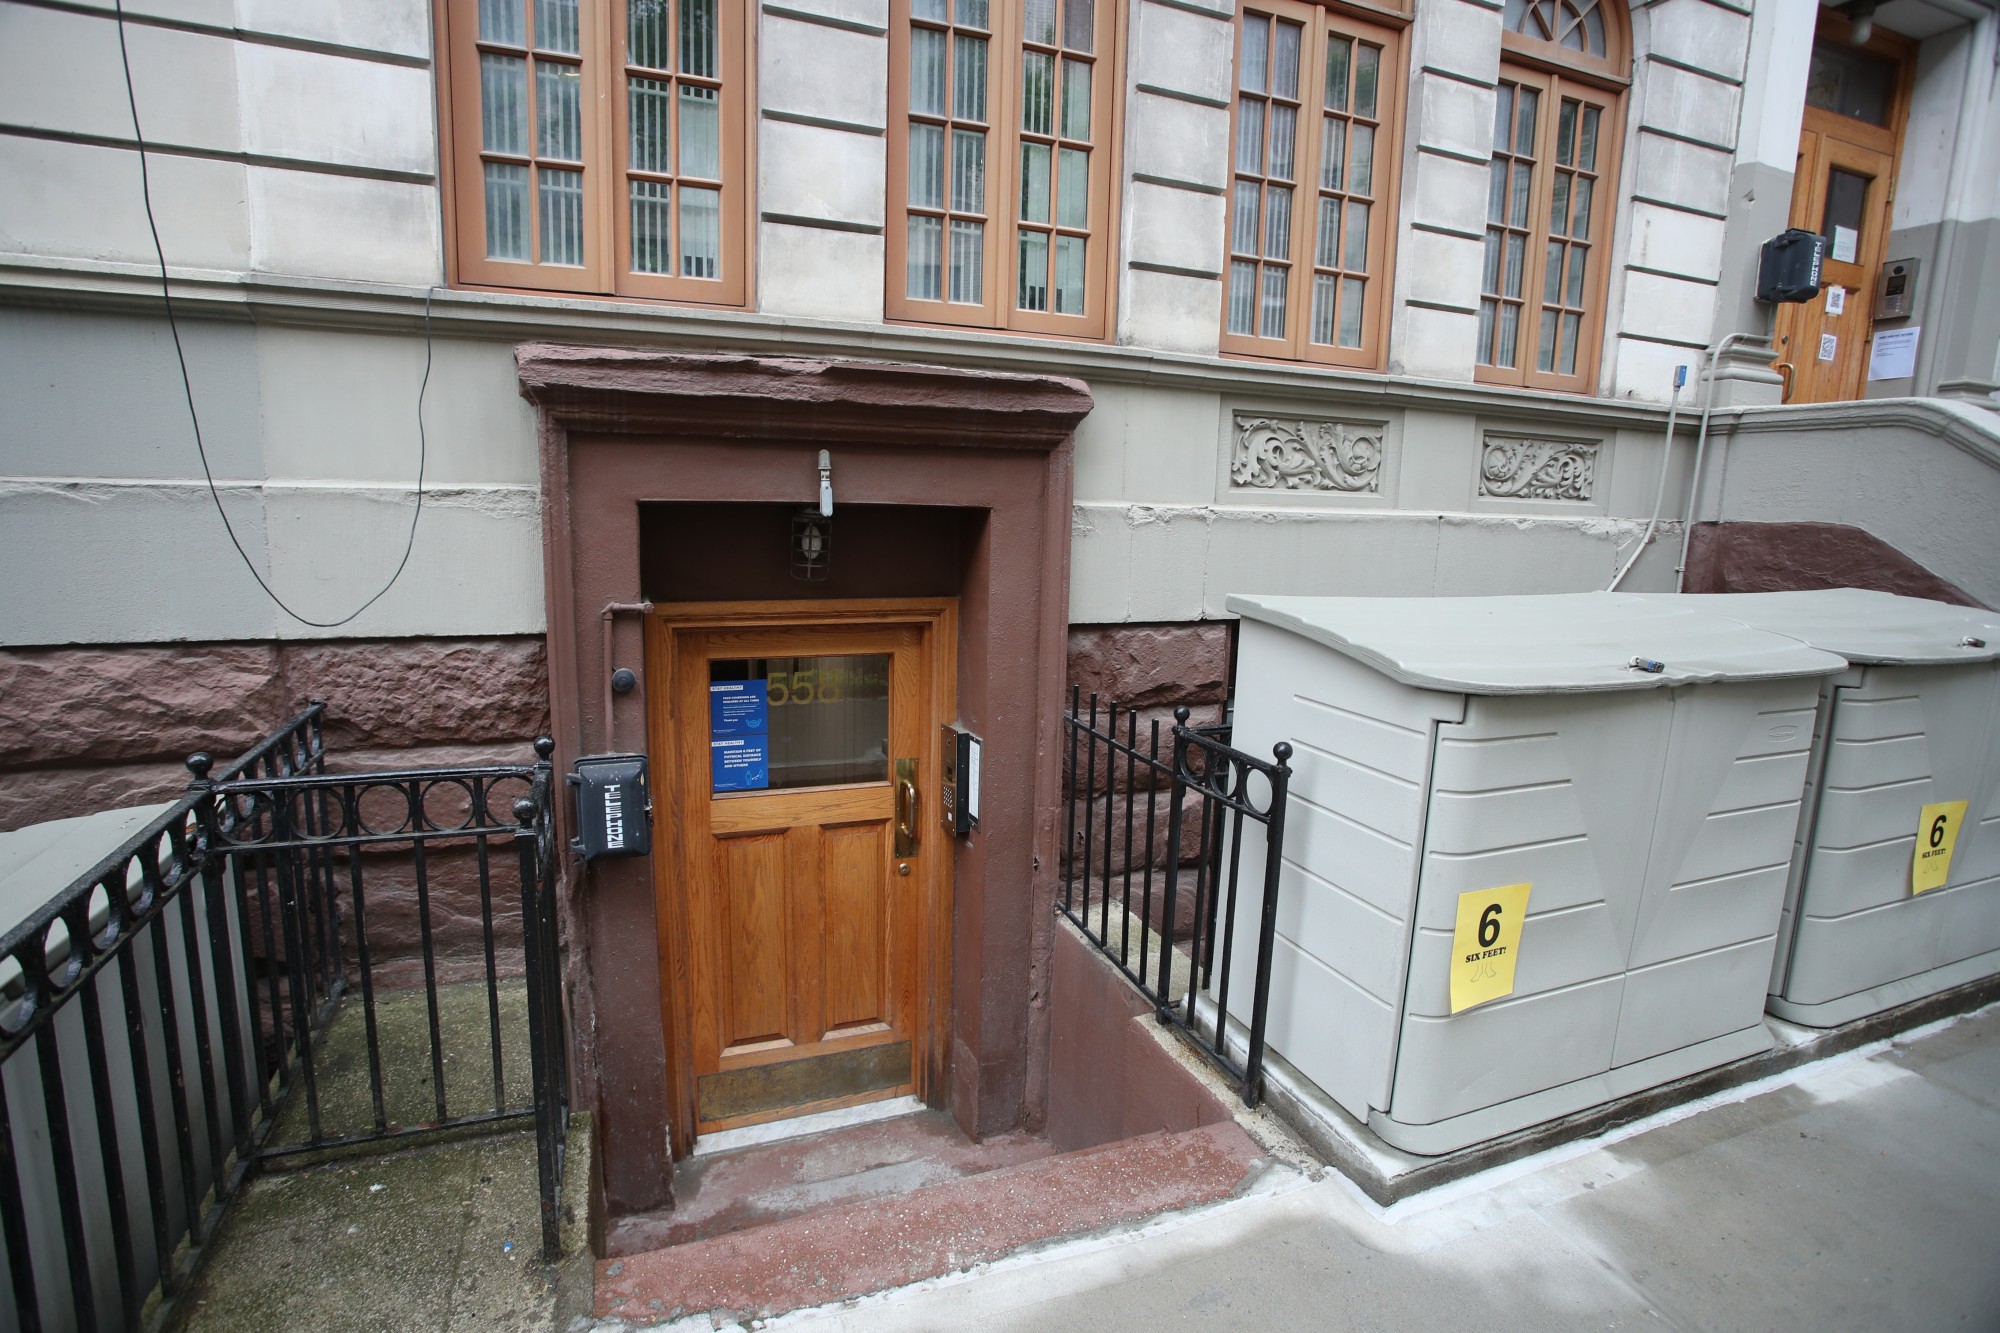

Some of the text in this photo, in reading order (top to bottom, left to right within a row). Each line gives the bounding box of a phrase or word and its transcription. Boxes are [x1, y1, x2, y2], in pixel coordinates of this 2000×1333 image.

[1810, 241, 1822, 286] TELEPHONE
[767, 669, 841, 706] 558
[604, 784, 624, 849] TELEPHONE
[1930, 814, 1947, 848] 6
[1931, 848, 1946, 857] FEET!
[1478, 904, 1502, 948] 6
[1465, 946, 1507, 964] SIX FEET!
